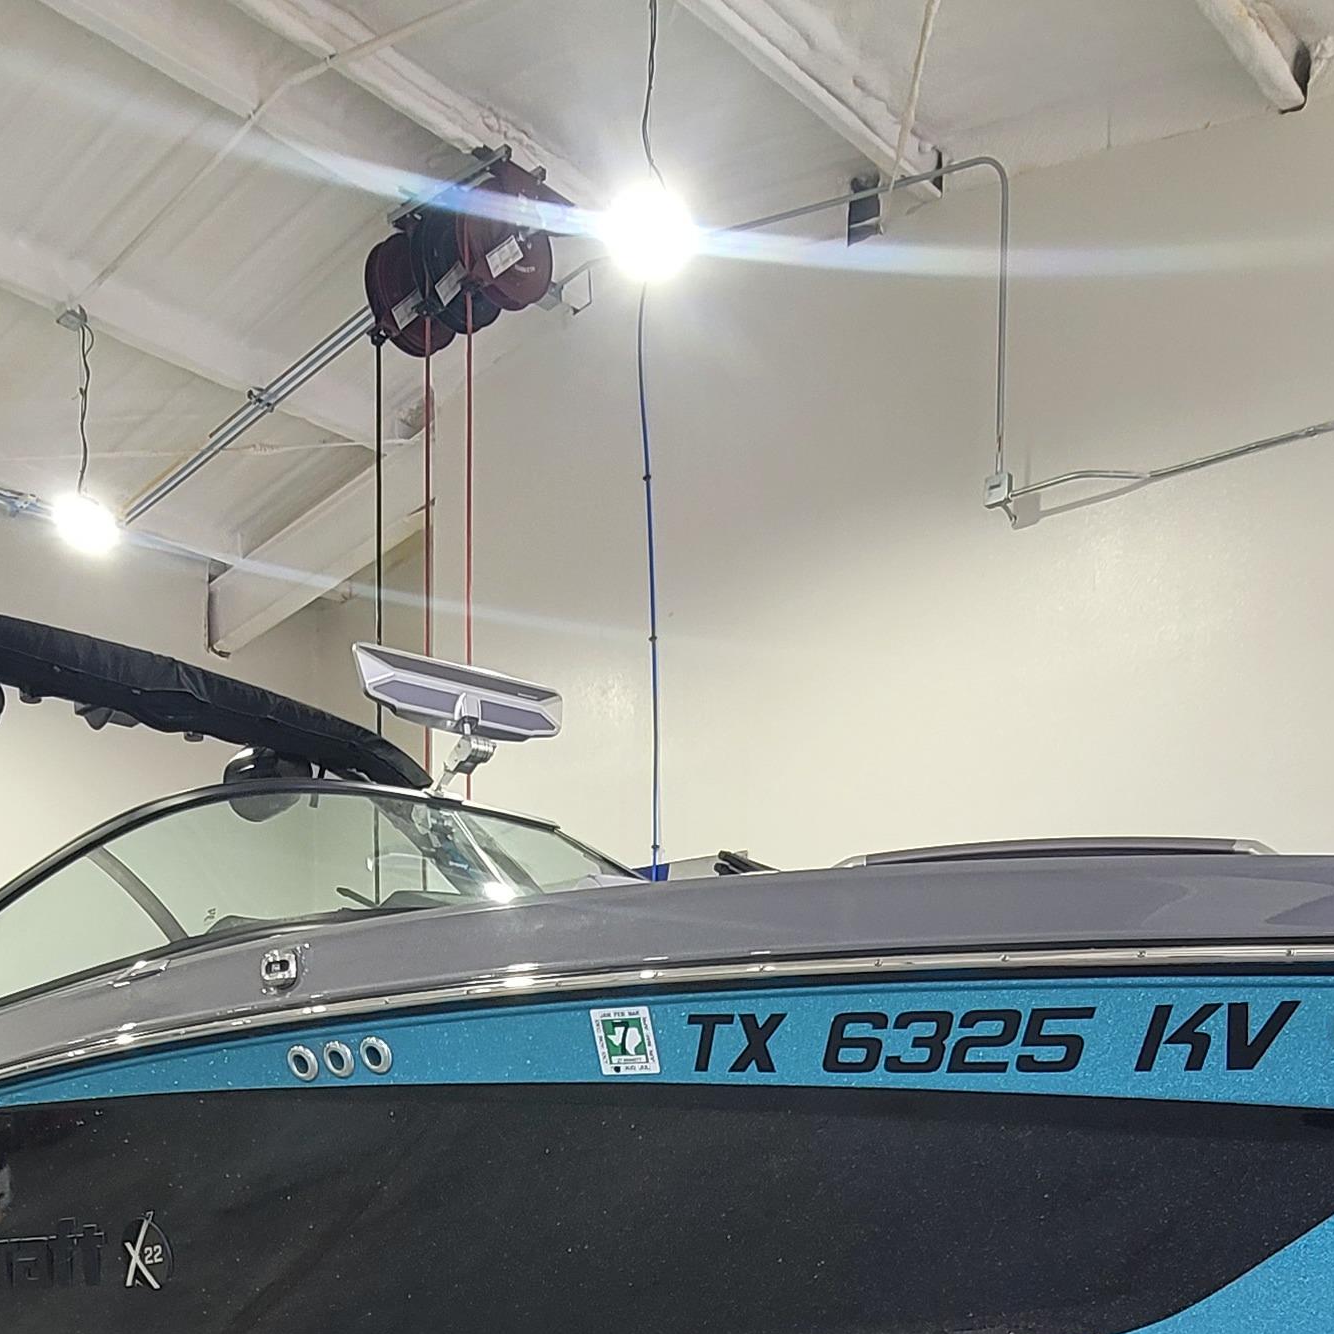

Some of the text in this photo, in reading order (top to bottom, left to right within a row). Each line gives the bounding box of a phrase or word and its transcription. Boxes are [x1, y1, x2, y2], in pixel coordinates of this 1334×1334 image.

[686, 1012, 788, 1073] TX
[821, 1006, 1096, 1073] 6325
[1133, 1000, 1302, 1072] KV
